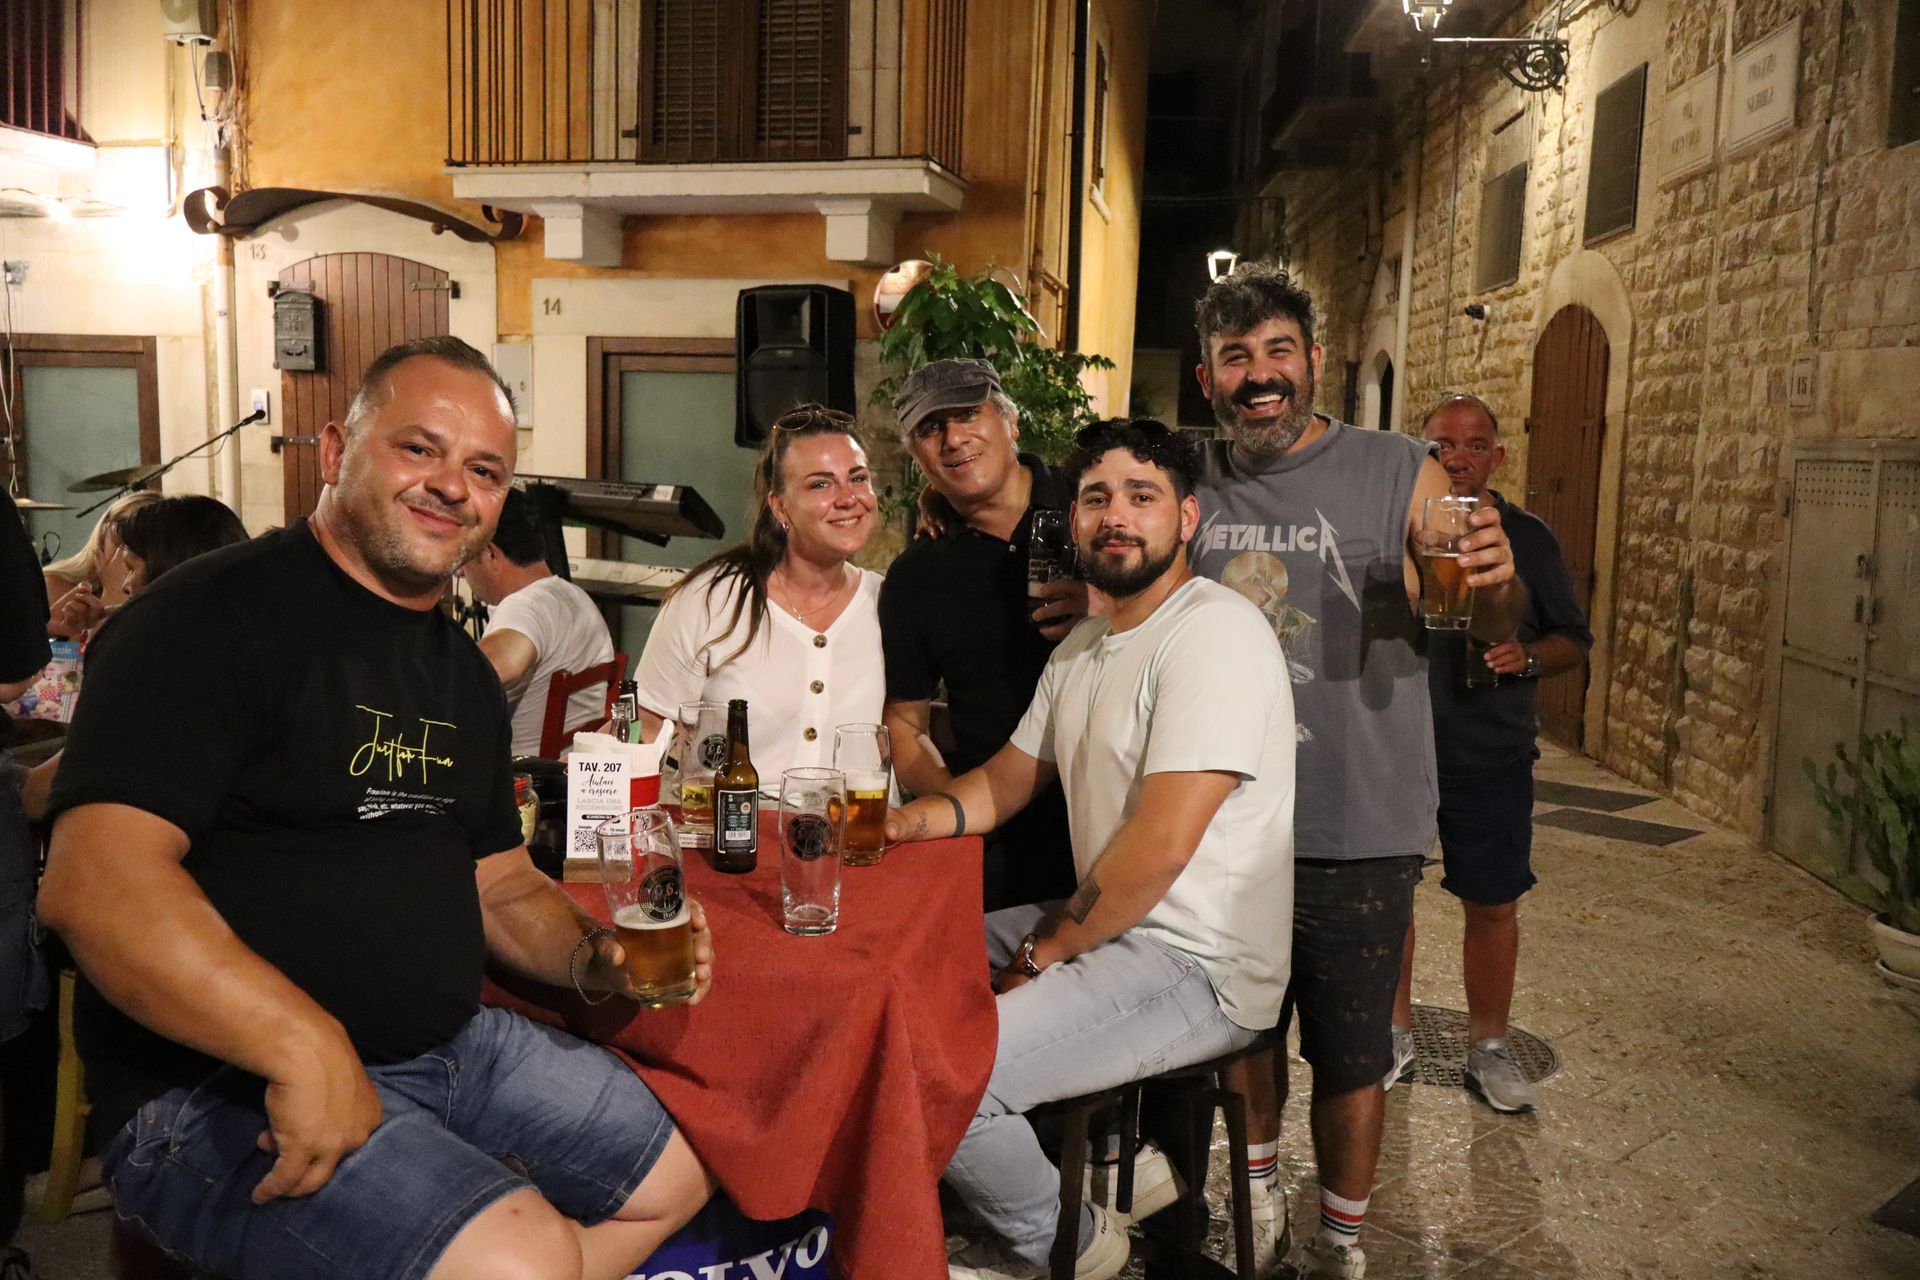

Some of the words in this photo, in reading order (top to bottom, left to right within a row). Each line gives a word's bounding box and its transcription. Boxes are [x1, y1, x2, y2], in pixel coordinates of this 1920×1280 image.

[250, 243, 266, 260] 13
[543, 297, 561, 316] 14
[1192, 508, 1361, 612] METALLICA
[418, 718, 457, 785] Fun
[579, 762, 601, 772] TAV.
[603, 762, 622, 773] 207
